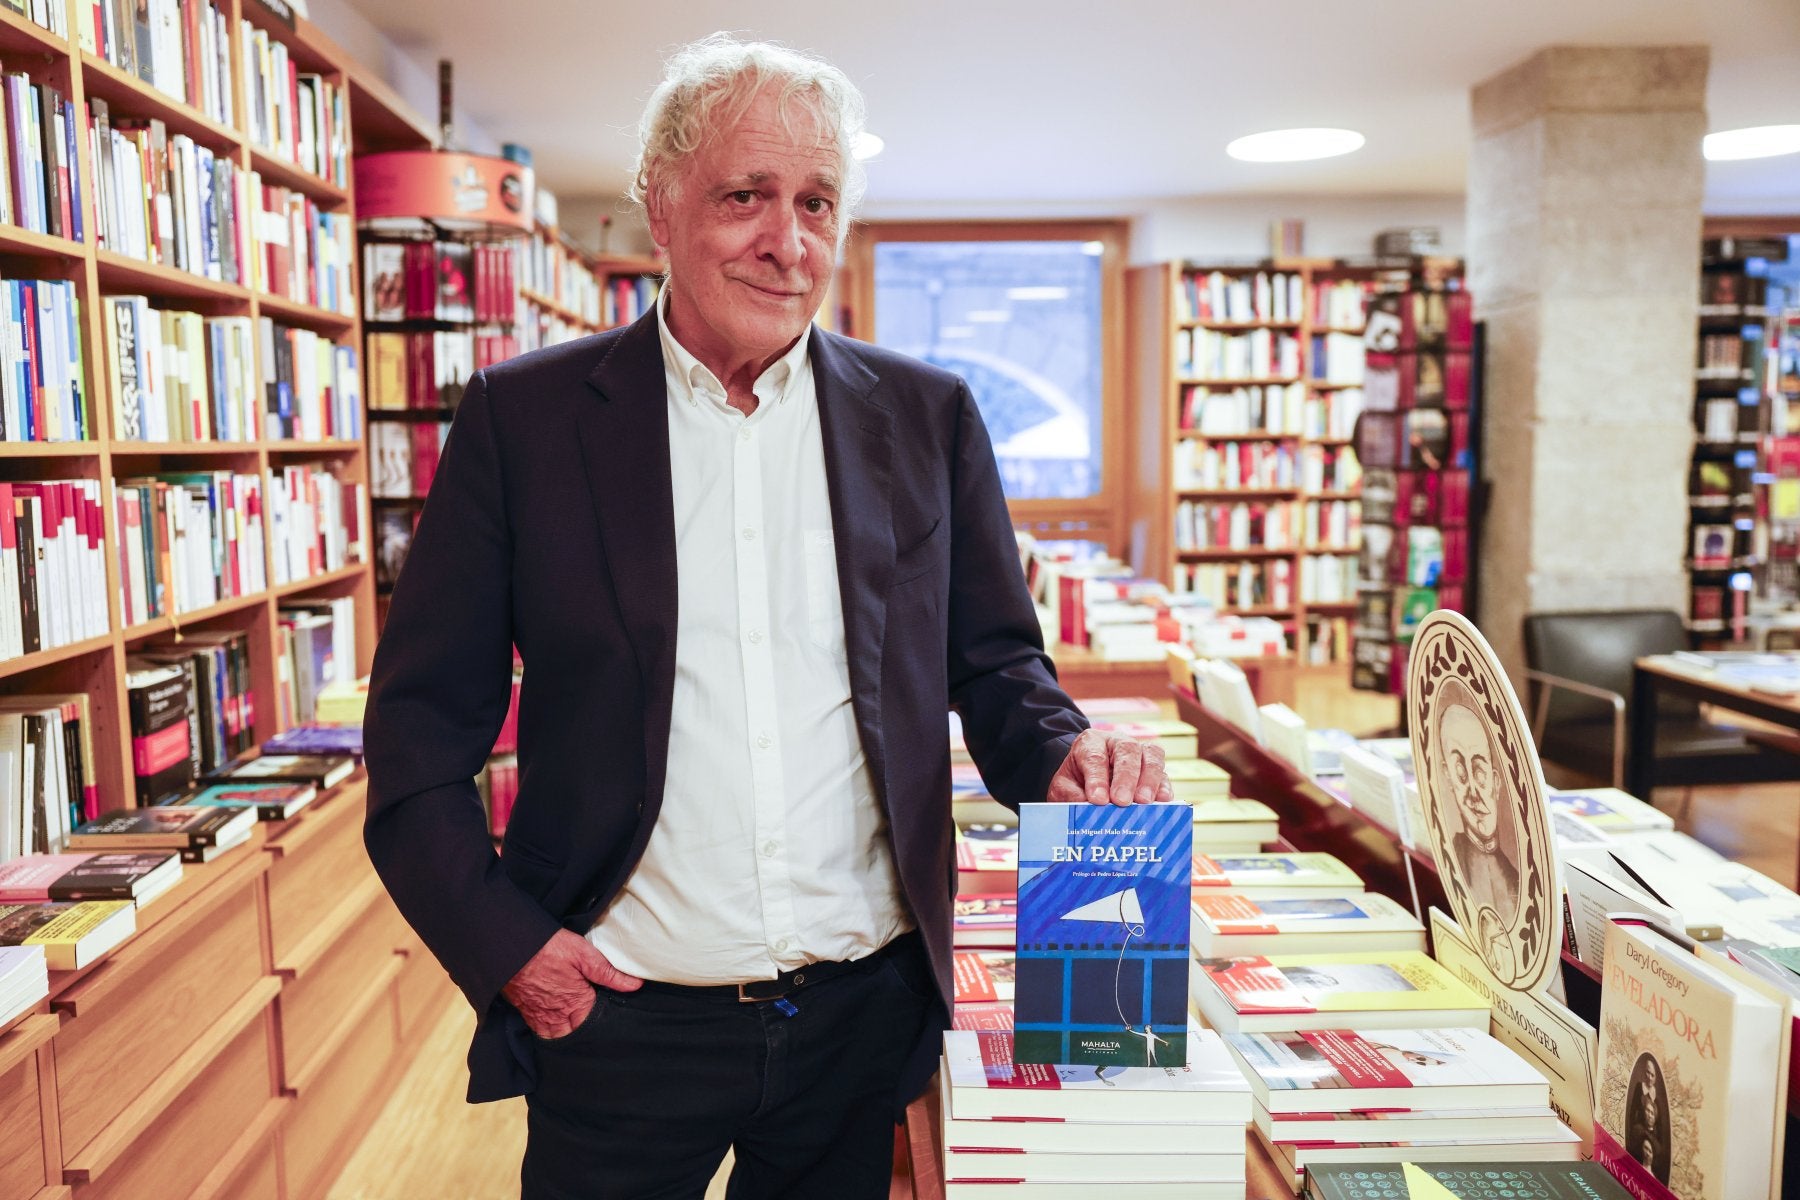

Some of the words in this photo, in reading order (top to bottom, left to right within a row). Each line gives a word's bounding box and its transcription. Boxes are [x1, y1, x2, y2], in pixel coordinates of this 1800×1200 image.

[1081, 828, 1103, 836] Miguel
[1122, 828, 1147, 837] Macaya
[1051, 846, 1084, 862] EN
[1090, 846, 1162, 863] PAPEL
[1626, 942, 1650, 970] Daryl
[1651, 960, 1689, 997] Gregory
[1491, 992, 1561, 1060] IREMONGER
[1550, 1100, 1572, 1127] ARIZ
[1600, 1150, 1620, 1178] JUAN
[1621, 1172, 1653, 1200] GÓME
